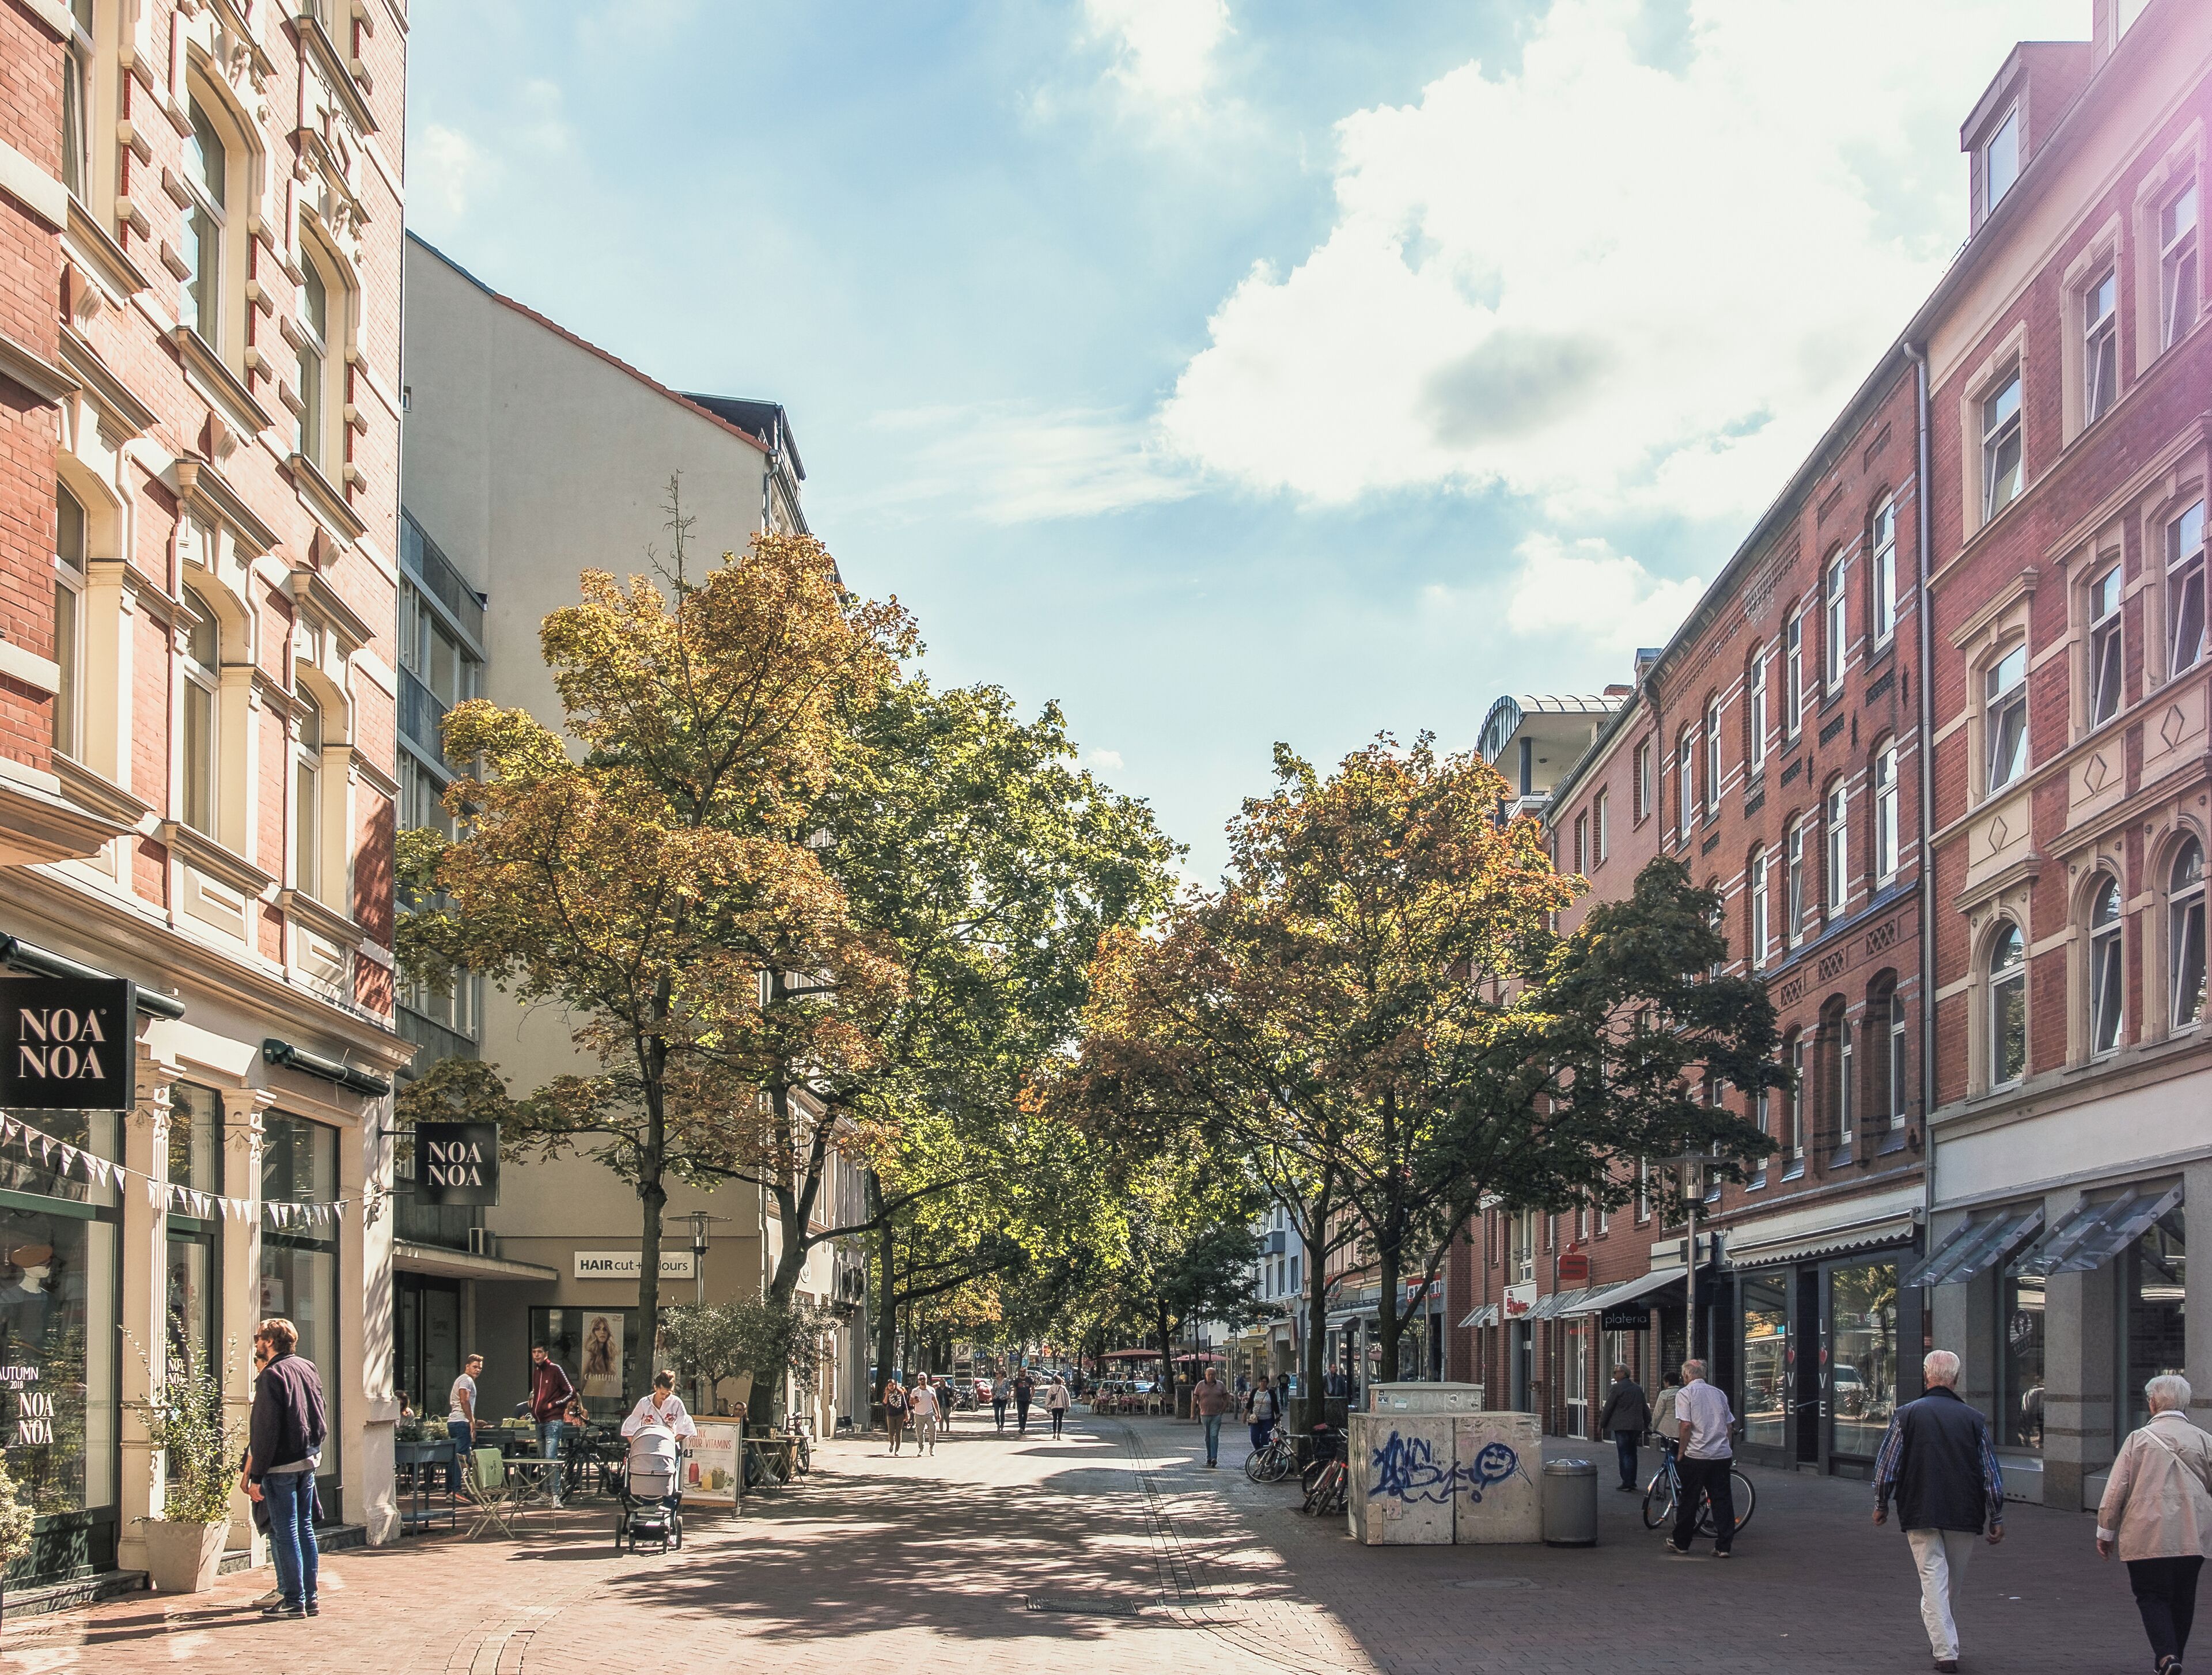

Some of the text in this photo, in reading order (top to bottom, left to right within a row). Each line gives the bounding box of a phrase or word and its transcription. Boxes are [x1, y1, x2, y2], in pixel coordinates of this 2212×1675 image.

[18, 1045, 106, 1079] NOA
[427, 1165, 482, 1186] NOA
[659, 1260, 688, 1271] lours
[1605, 1313, 1647, 1328] plateria
[19, 1392, 55, 1417] NOA
[18, 1420, 54, 1445] NOA
[690, 1428, 706, 1438] INK
[688, 1438, 731, 1450] YOUR VITAMINS
